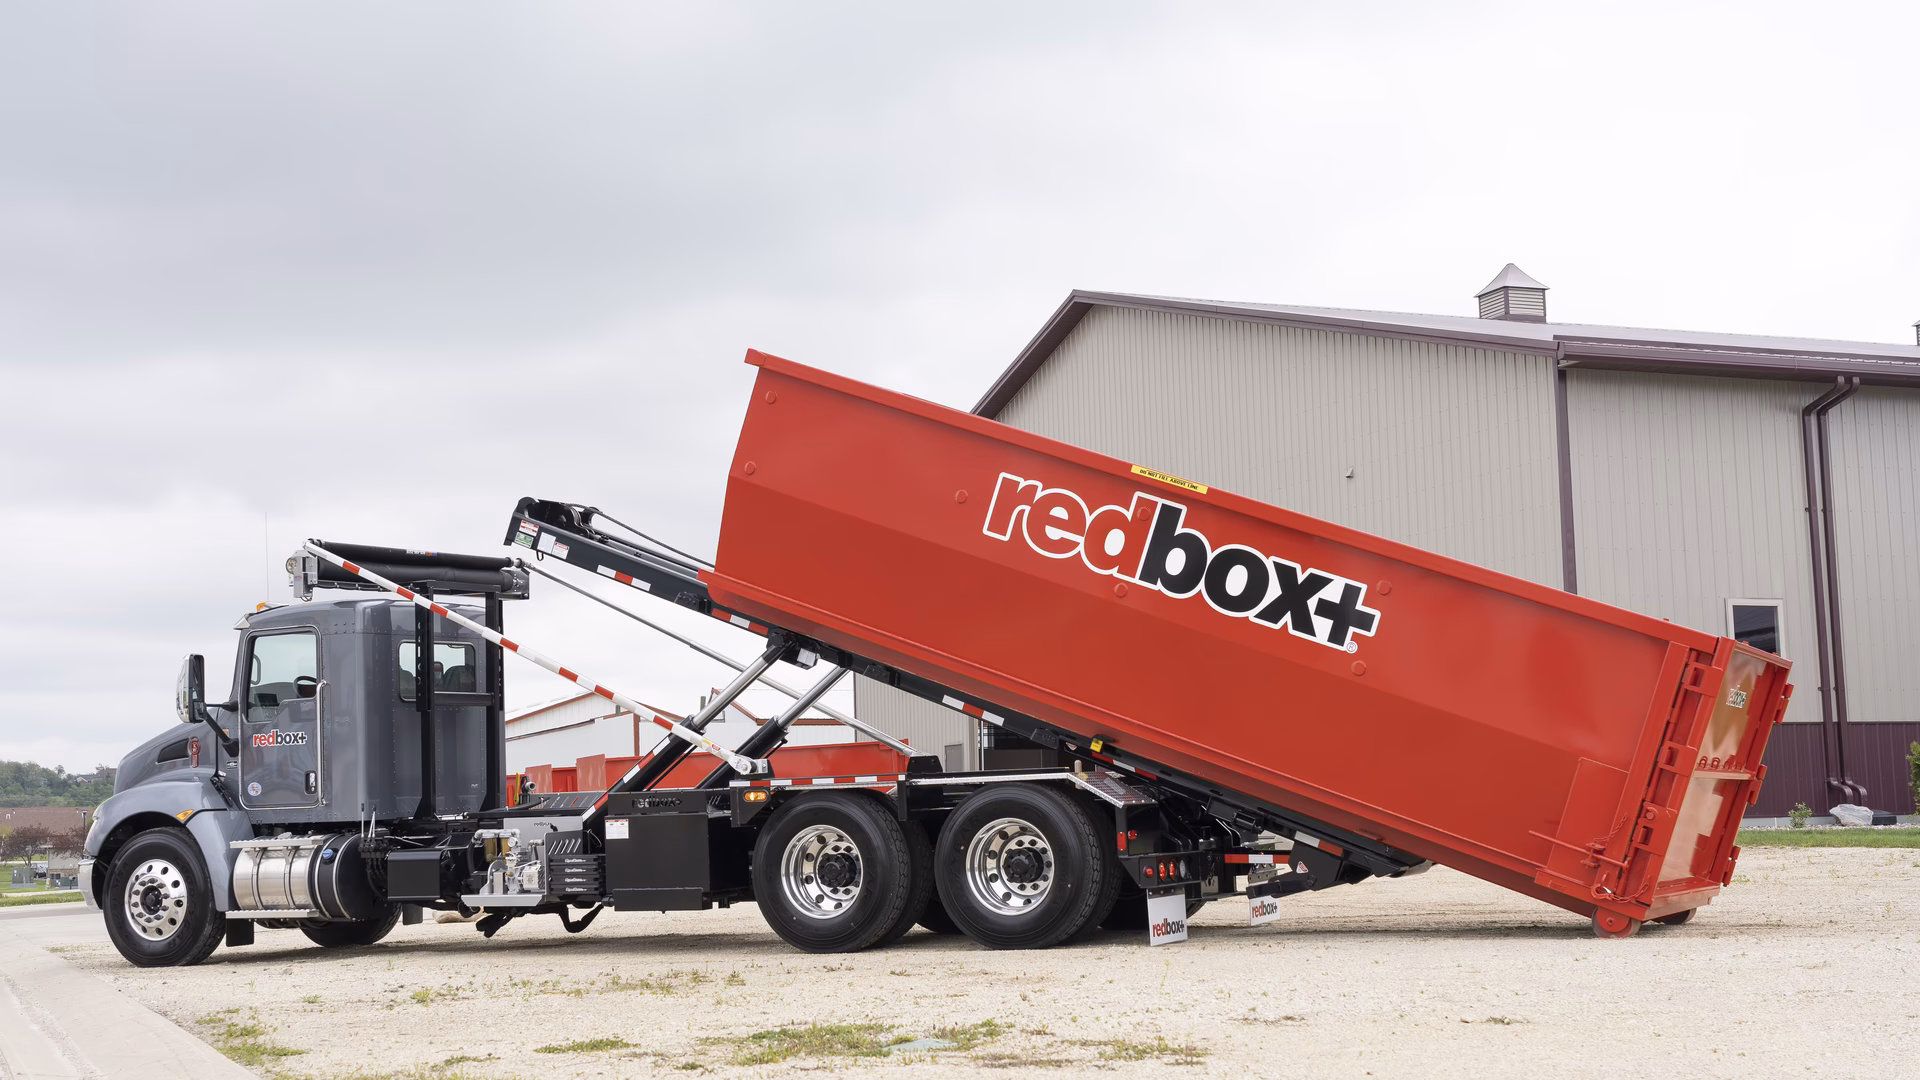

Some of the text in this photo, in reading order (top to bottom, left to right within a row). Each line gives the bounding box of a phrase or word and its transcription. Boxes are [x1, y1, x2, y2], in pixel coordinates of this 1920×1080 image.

[253, 729, 307, 747] redbox+
[1251, 900, 1278, 918] redbox+
[1152, 917, 1185, 937] redbox+
